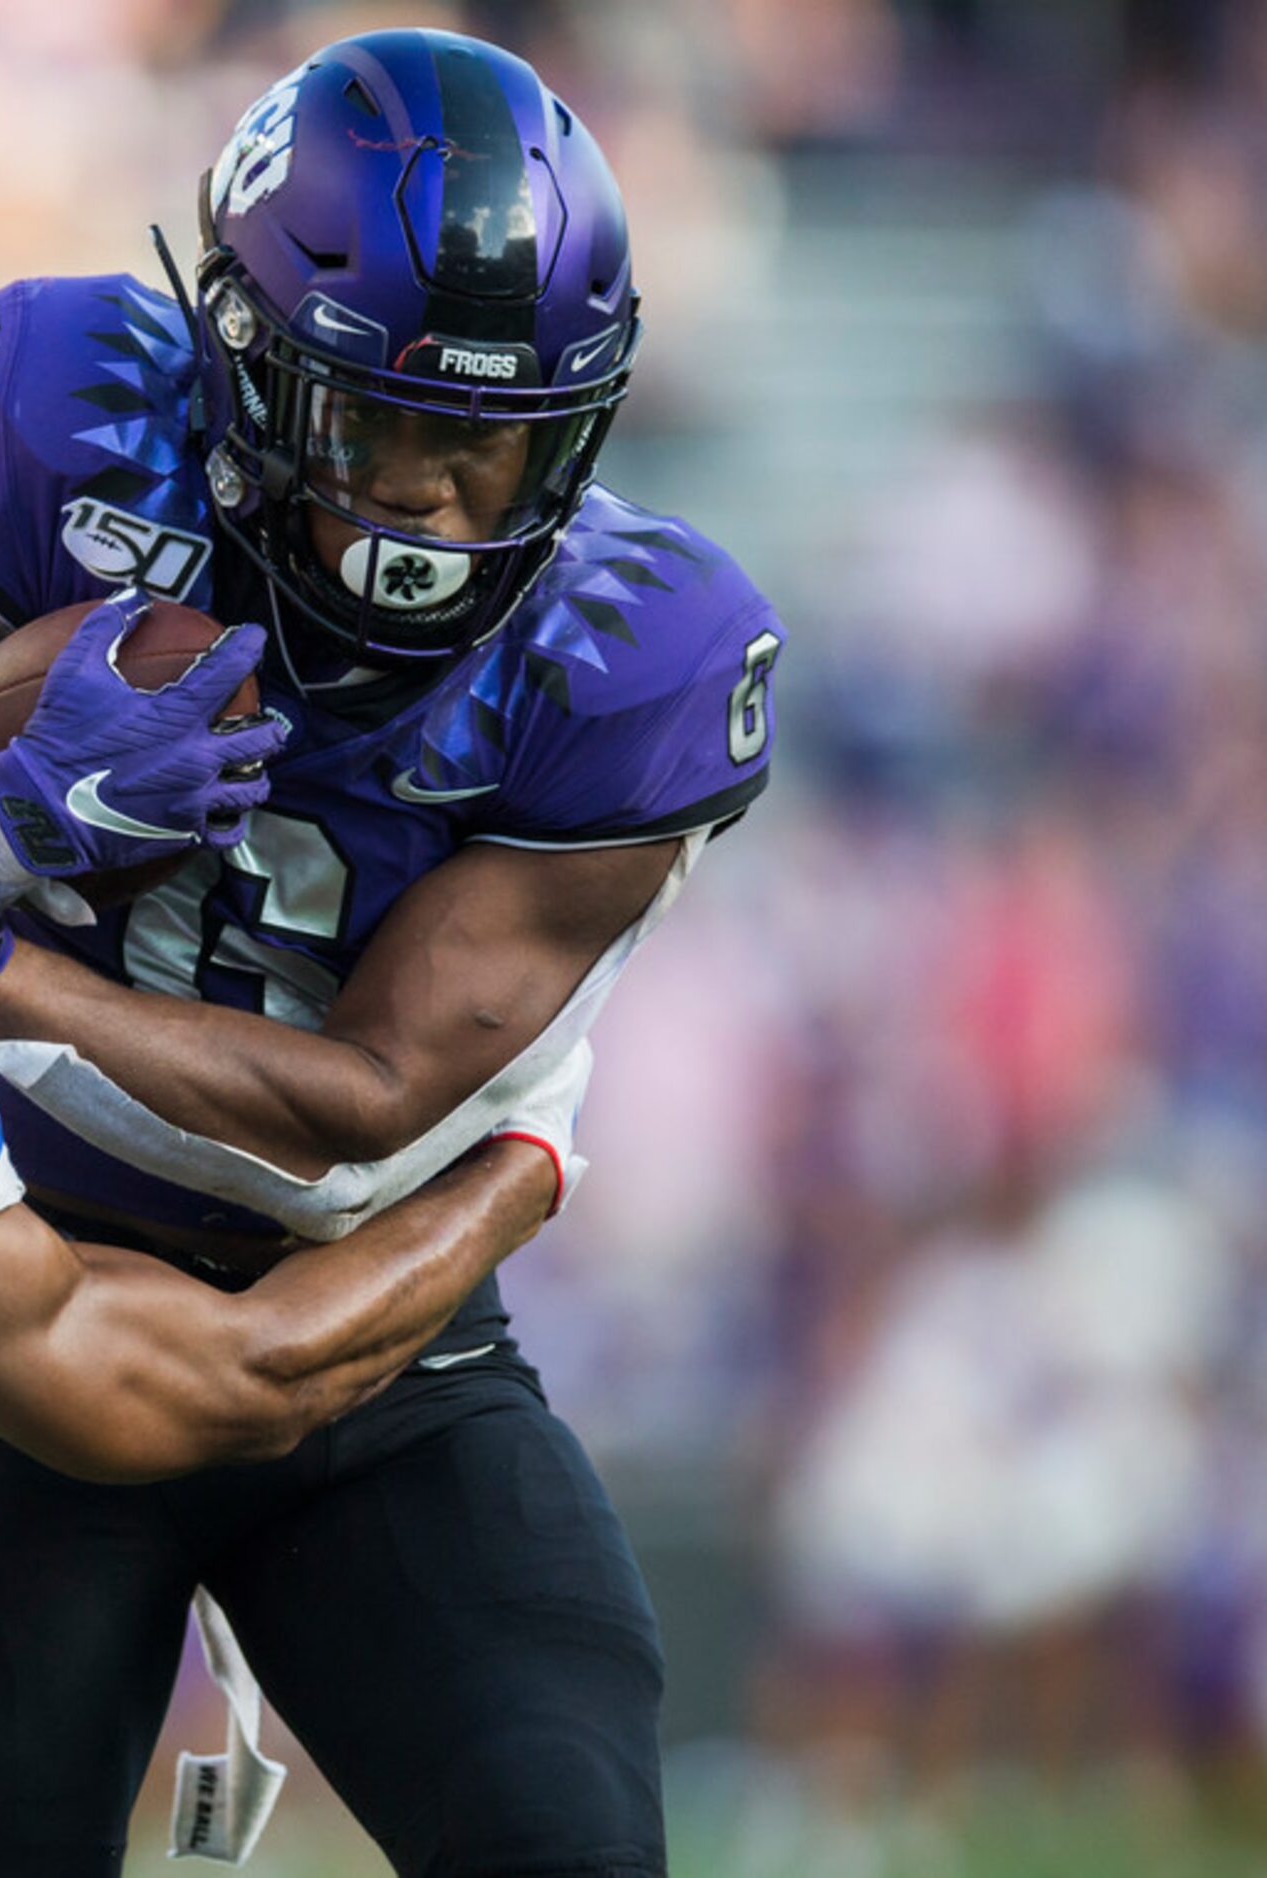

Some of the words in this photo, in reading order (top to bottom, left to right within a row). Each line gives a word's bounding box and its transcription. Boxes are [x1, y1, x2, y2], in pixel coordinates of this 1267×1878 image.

[439, 347, 518, 379] FROGS
[62, 498, 211, 598] 150
[728, 629, 781, 767] 6
[123, 806, 351, 1032] 6
[198, 1765, 218, 1799] WE
